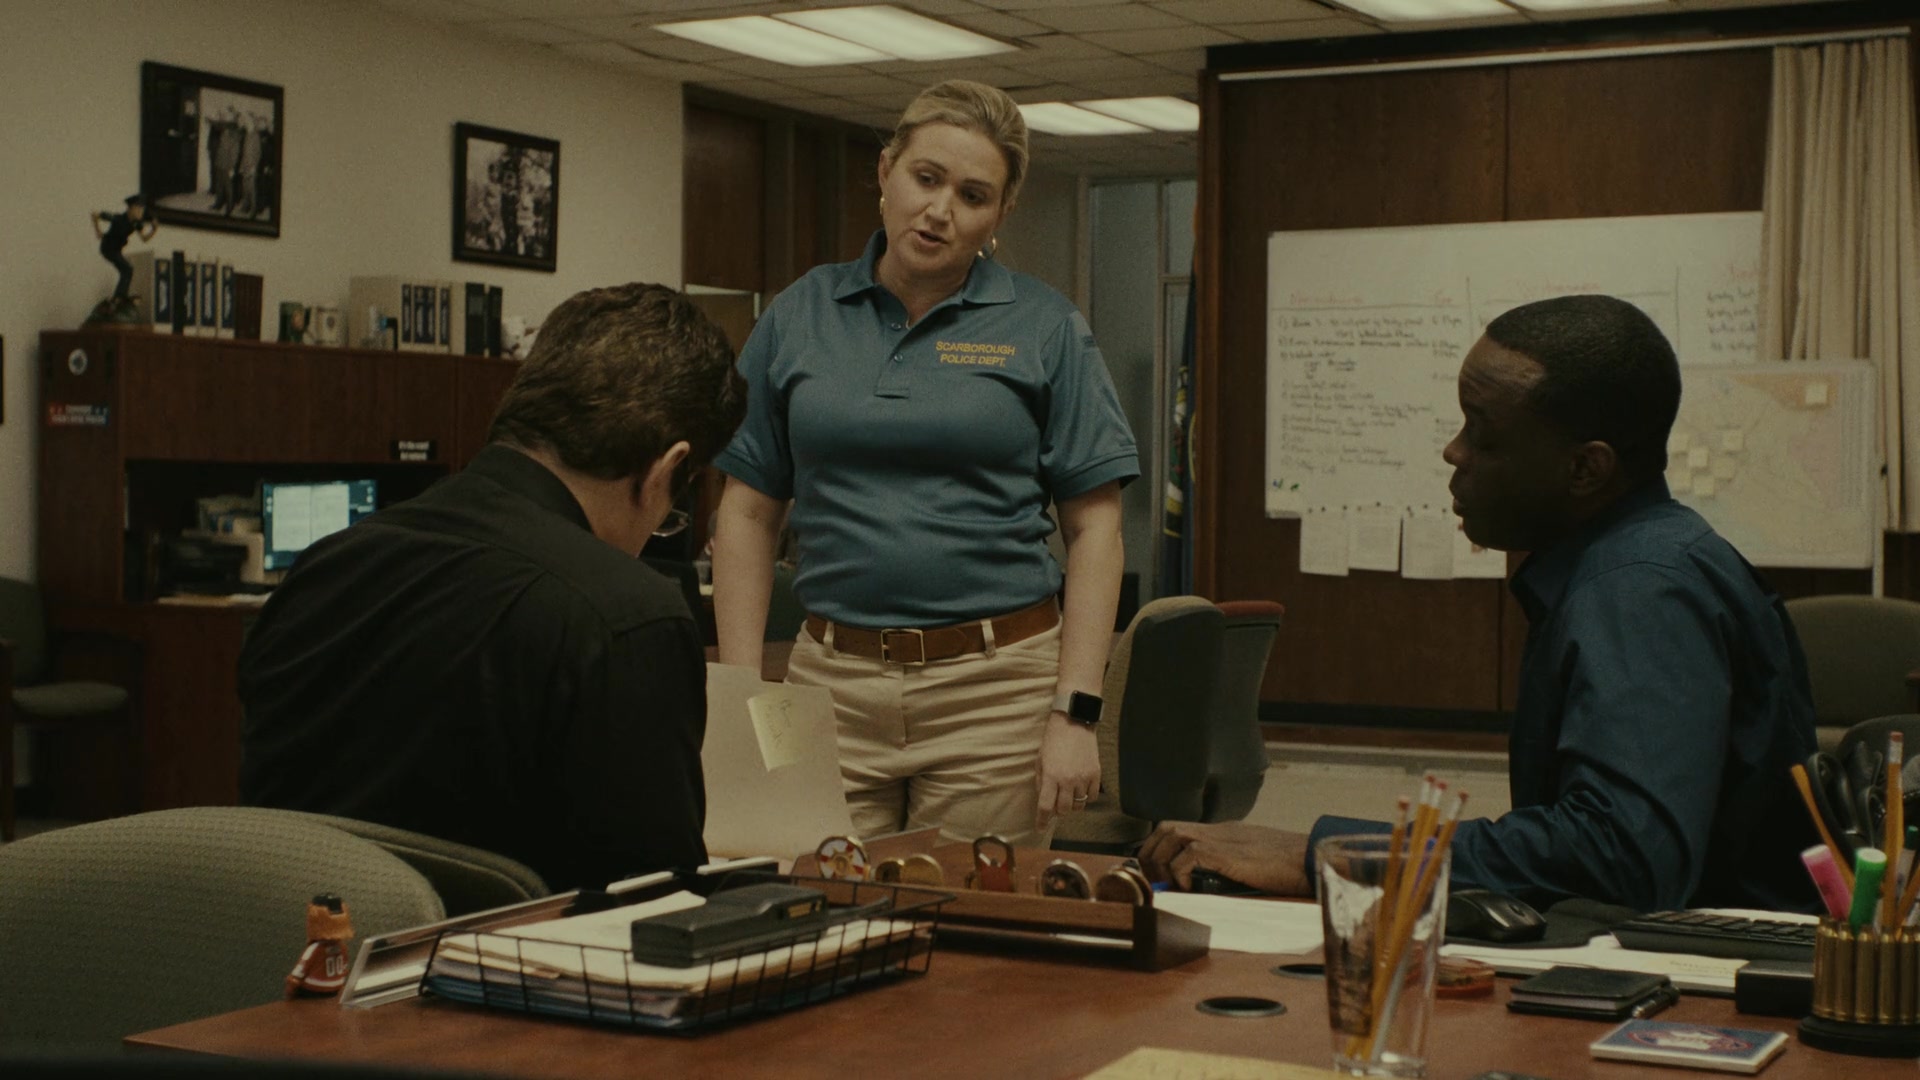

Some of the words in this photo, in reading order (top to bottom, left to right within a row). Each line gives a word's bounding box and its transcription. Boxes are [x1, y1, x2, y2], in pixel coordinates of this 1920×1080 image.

[936, 341, 1015, 355] SCARBOROUGH
[940, 353, 977, 364] POLICE
[978, 356, 1006, 367] DEPT.
